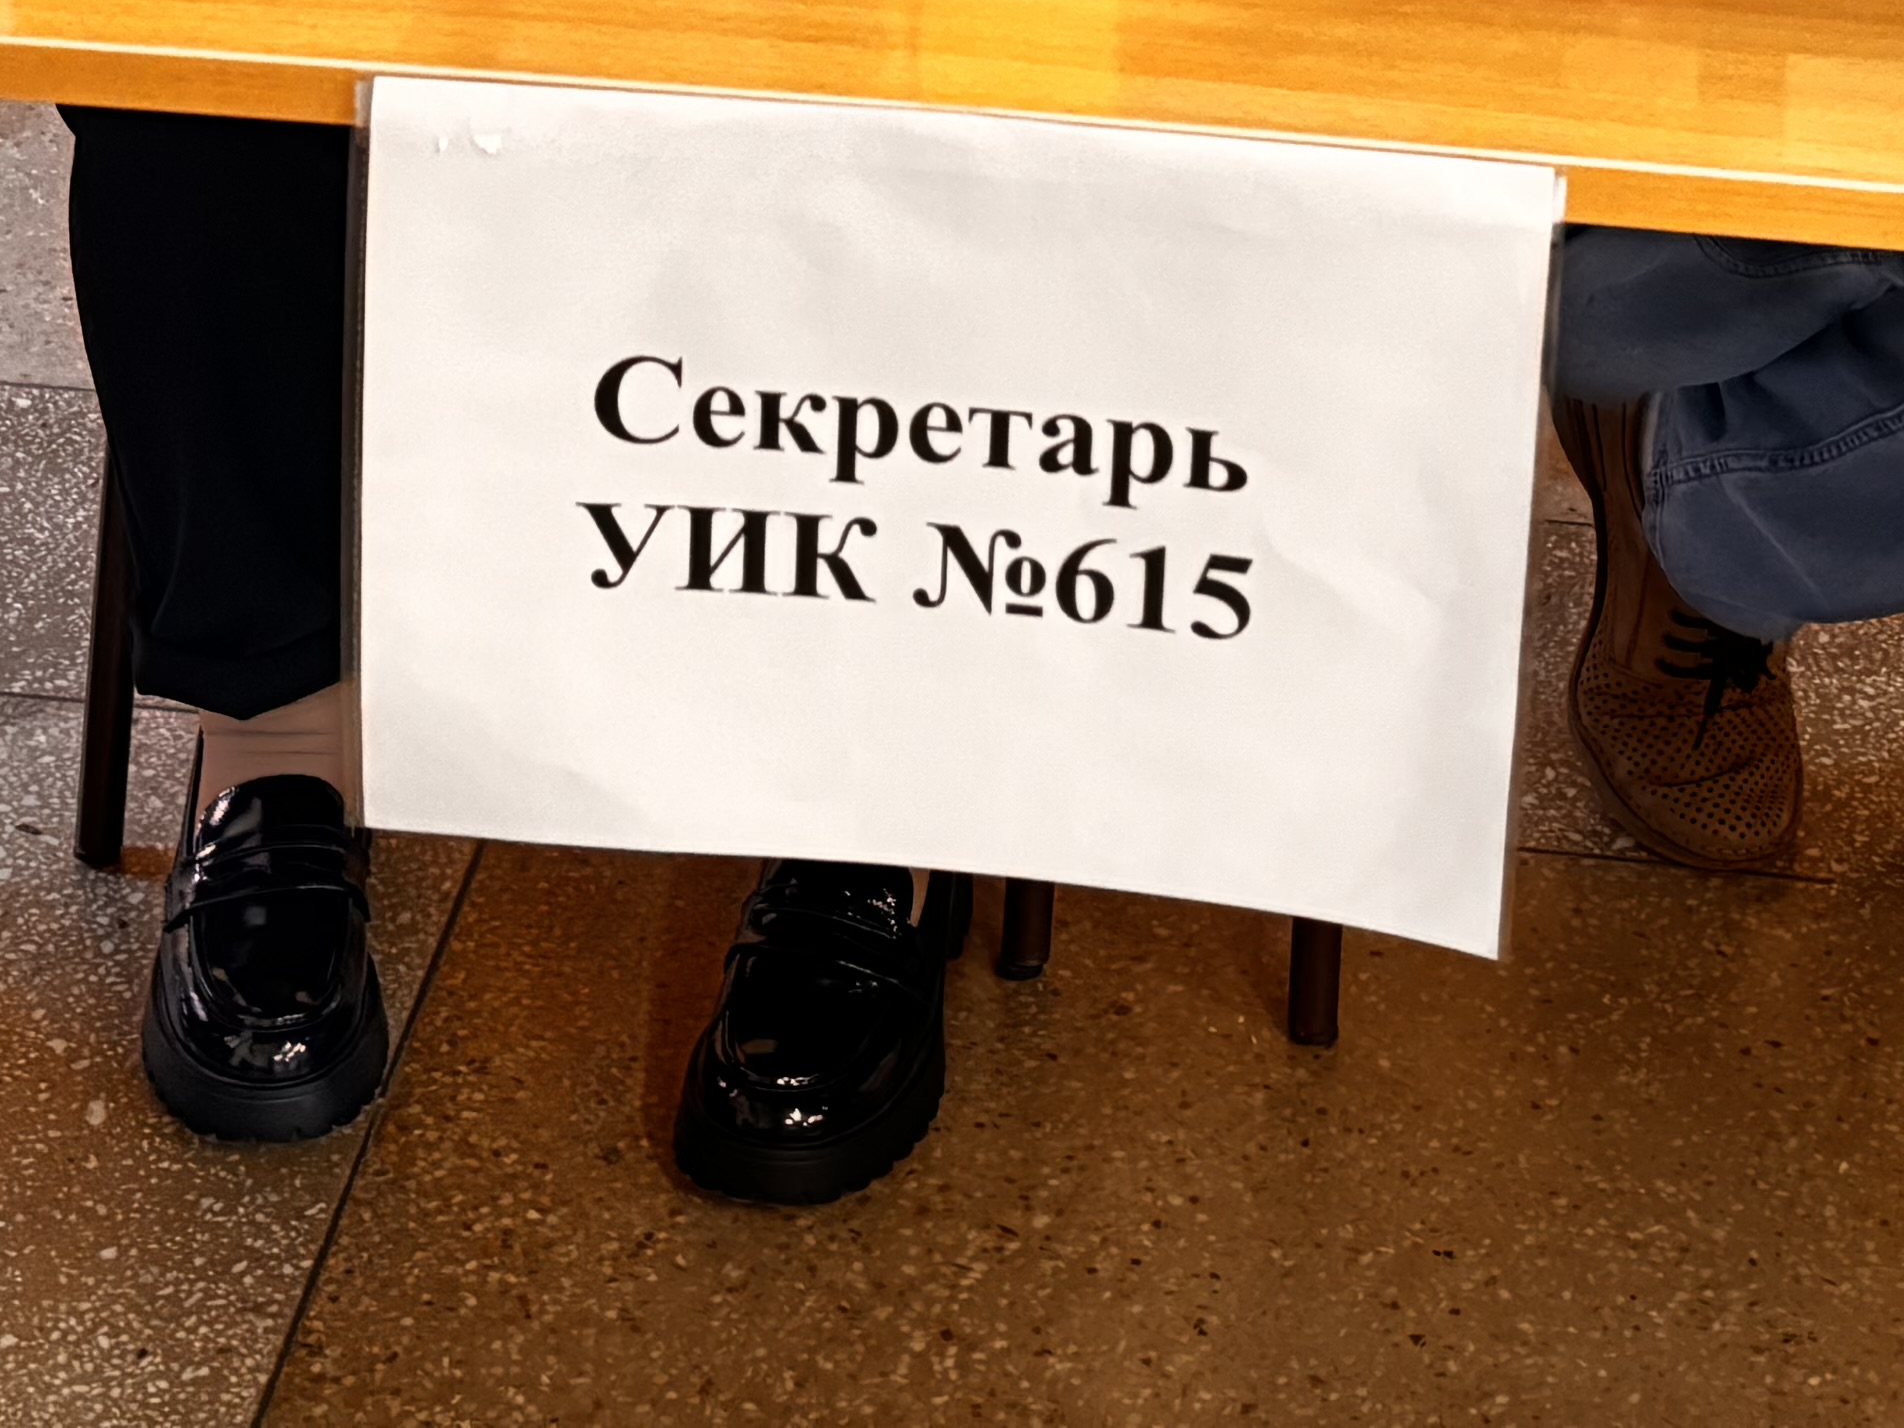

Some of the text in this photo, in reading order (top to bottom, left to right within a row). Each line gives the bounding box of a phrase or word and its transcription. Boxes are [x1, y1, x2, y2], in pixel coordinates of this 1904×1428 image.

[592, 354, 1250, 510] Секретарь
[575, 500, 1254, 641] УИК №615
